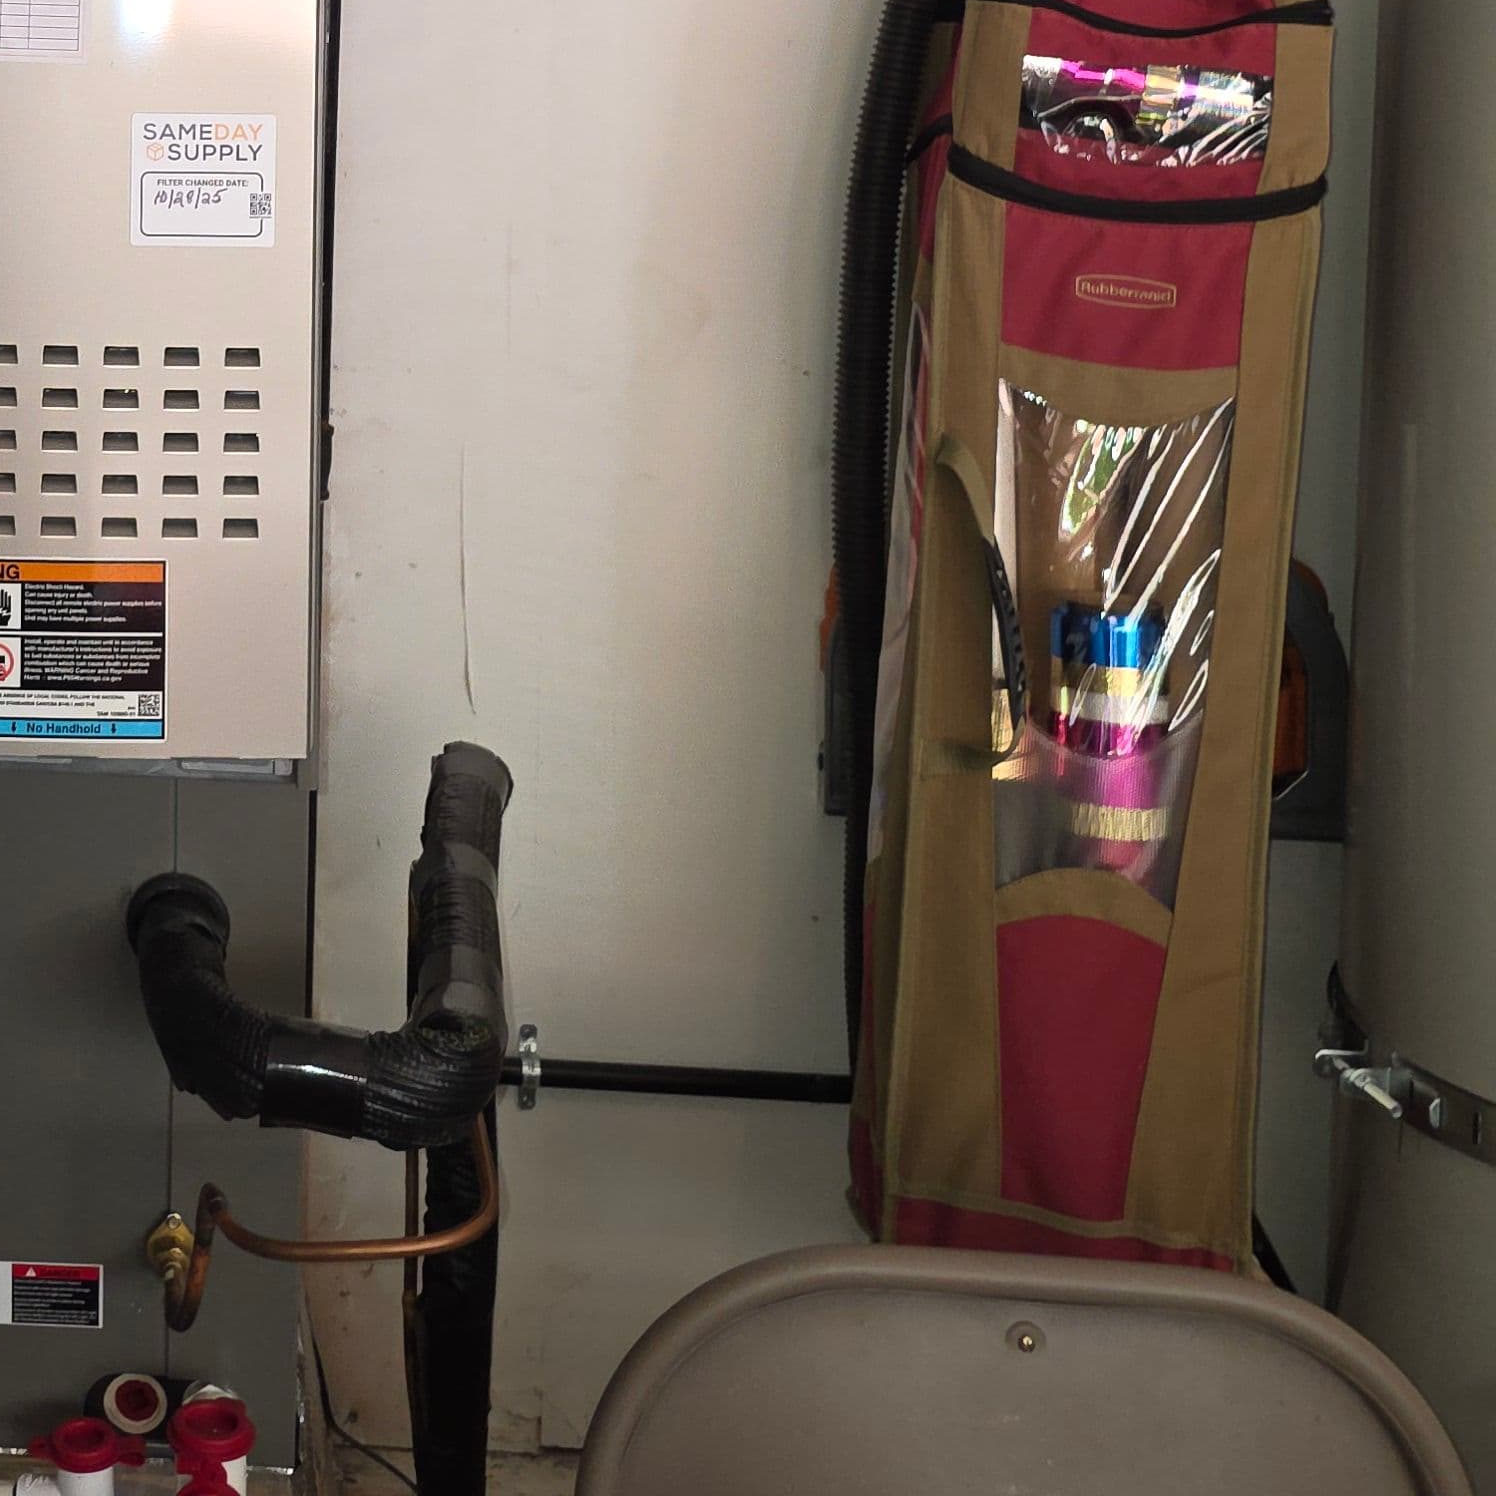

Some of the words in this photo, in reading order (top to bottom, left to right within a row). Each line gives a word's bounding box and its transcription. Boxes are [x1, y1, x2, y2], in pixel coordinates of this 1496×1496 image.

[142, 122, 264, 141] SAMEDAY
[167, 143, 264, 161] SUPPLY
[157, 178, 183, 186] FILTER
[185, 179, 224, 187] CHANGED
[225, 179, 249, 187] DATE:
[154, 187, 228, 210] 10/28/25
[1081, 280, 1172, 302] Rubbermaid
[26, 723, 43, 733] No
[46, 723, 101, 734] Handhold
